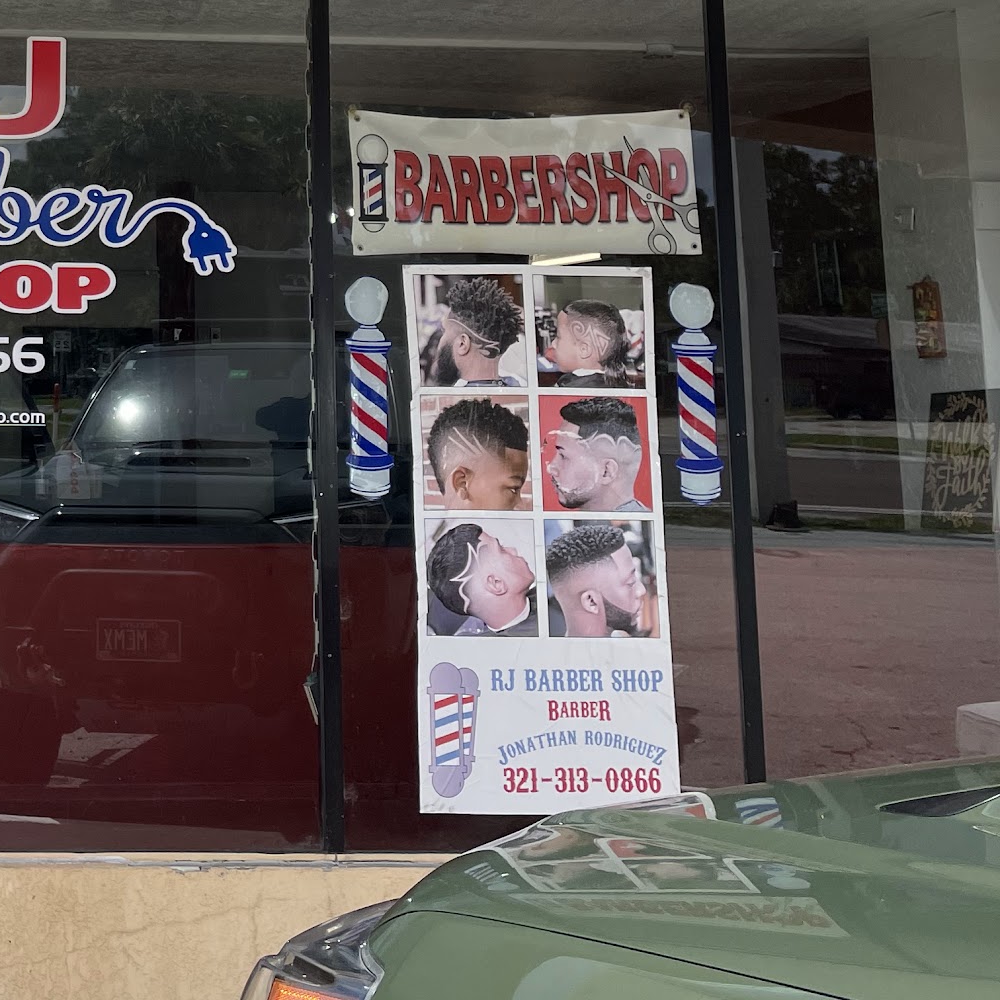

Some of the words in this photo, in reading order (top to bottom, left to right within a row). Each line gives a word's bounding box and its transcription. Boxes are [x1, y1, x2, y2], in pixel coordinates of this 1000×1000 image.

[394, 147, 688, 225] BARBERSHOP
[490, 668, 515, 692] RJ
[525, 669, 604, 692] BARBER
[611, 669, 663, 692] SHOP
[497, 730, 577, 765] JONATHAN
[584, 730, 667, 765] RODRIGUEZ
[503, 767, 662, 793] 321-313-0866
